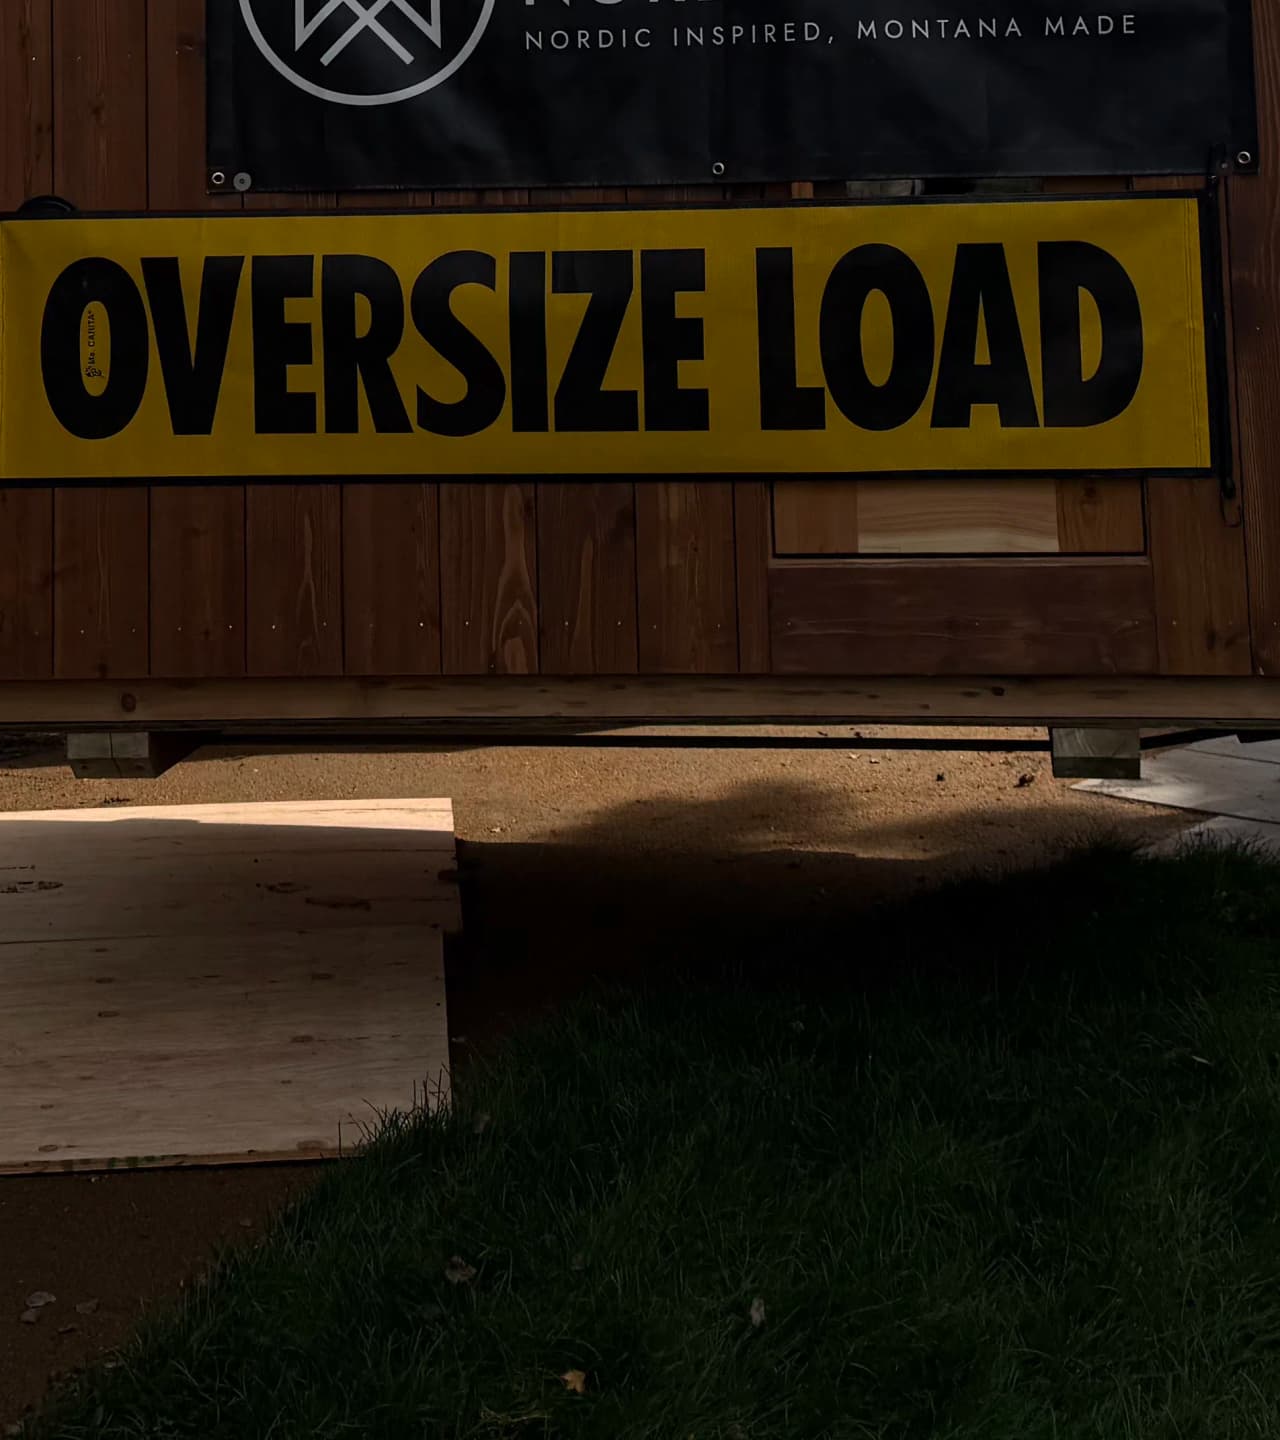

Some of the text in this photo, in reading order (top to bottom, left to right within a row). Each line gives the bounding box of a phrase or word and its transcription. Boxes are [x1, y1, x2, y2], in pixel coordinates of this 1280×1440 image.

[524, 14, 1136, 50] NORDIC INSPIRED, MONTANA MADE
[39, 239, 1144, 441] OVERSIZE LOAD
